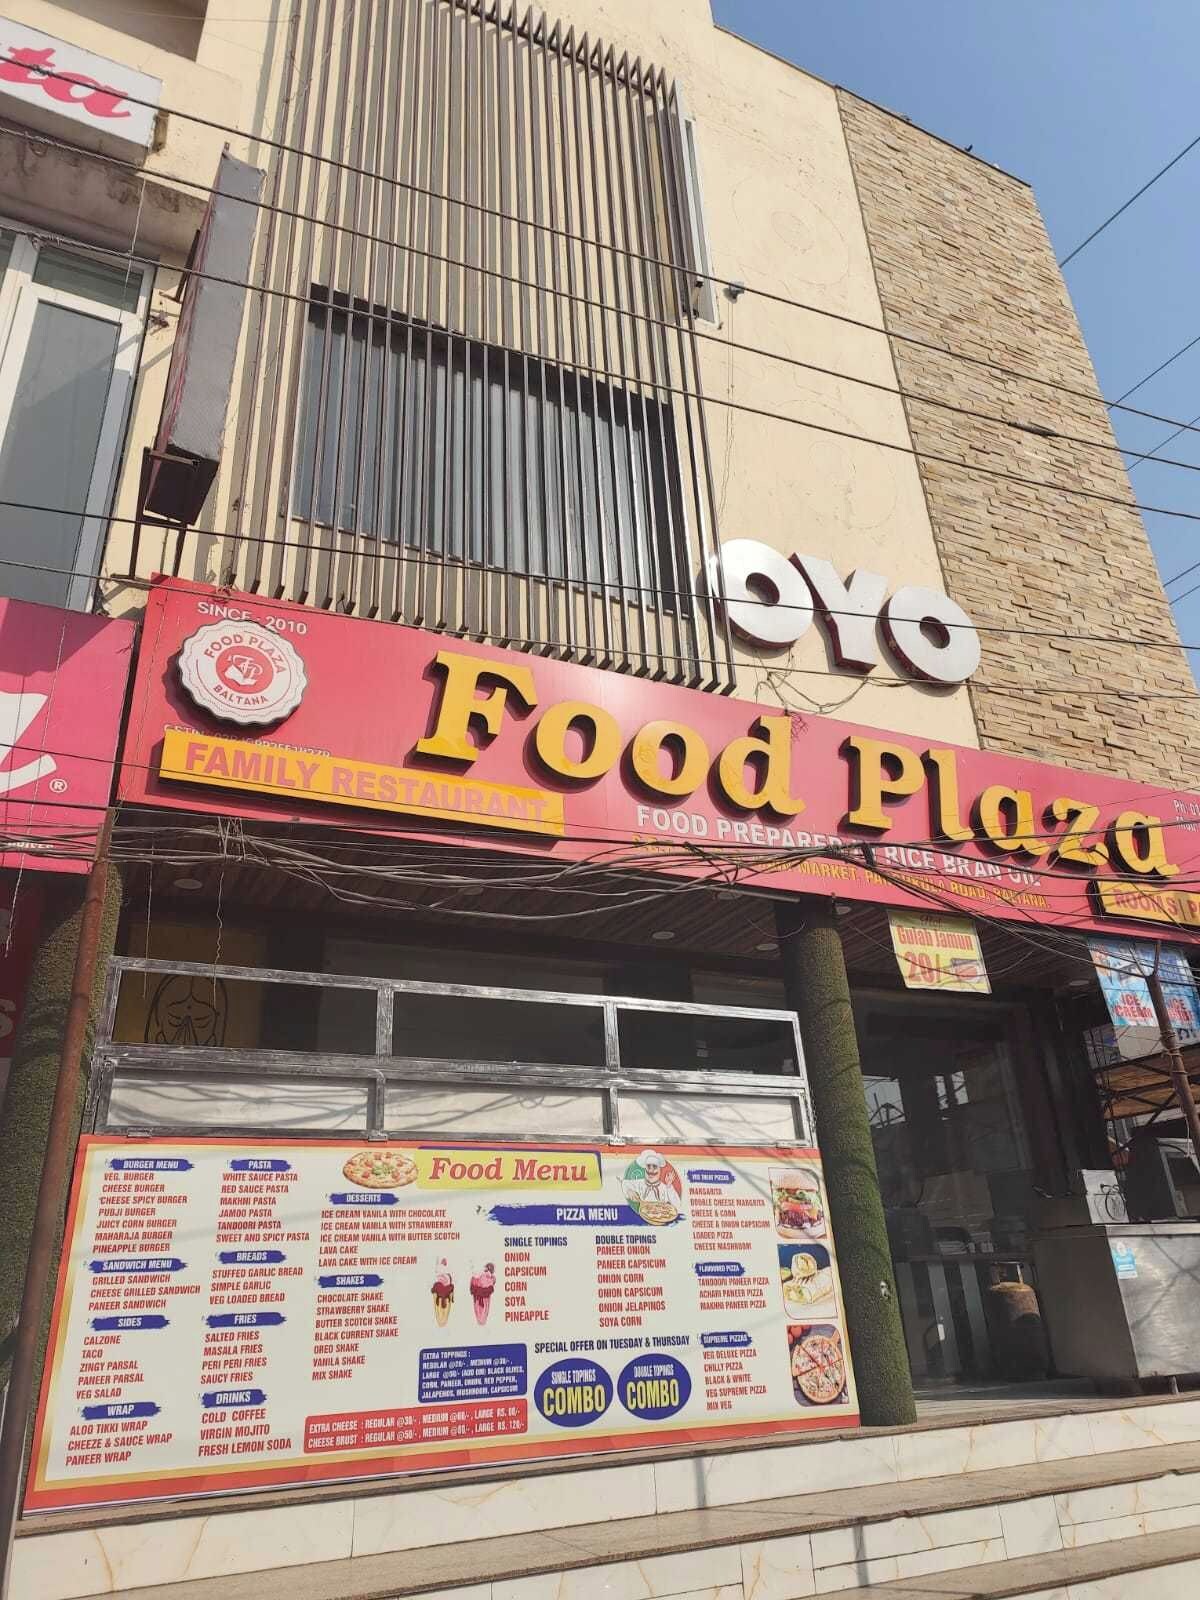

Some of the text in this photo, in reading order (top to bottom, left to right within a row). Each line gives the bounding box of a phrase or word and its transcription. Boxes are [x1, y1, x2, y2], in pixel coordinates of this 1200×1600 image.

[0, 46, 131, 118] ta
[708, 538, 981, 683] OYO
[265, 615, 308, 635] 2010
[203, 633, 287, 674] FOOD PLAZA
[212, 684, 269, 706] BALTANA
[416, 650, 1180, 878] Food Plaza
[184, 741, 549, 821] FAMILY RESTAURANT
[636, 805, 709, 837] FOOD
[885, 845, 936, 870] RICE
[943, 852, 1001, 879] BRAN
[896, 925, 974, 951] Gulab Jamun
[123, 1160, 179, 1169] BURGER MENU
[248, 1160, 272, 1169] PASTA
[429, 1157, 588, 1183] Food Menu
[222, 1173, 298, 1181] WHITE SAUCE PASTA
[102, 1184, 165, 1193] CHEESE BURGER
[100, 1195, 188, 1205] CHEESE SPICY BURGER
[346, 1194, 381, 1202] DESSERTS
[556, 1207, 618, 1221] PIZZA MENU
[216, 1232, 310, 1243] SWEET AND SPICY PASTA
[320, 1232, 460, 1242] ICE CREAM VANILA WITH BUTTER SCOTCH
[504, 1236, 568, 1247] SINGLE TOPINGS
[595, 1235, 657, 1245] DOUBLE TOPINGS
[92, 1243, 170, 1254] PINEAPPLE BURGER
[596, 1246, 651, 1256] PANEER ONION
[236, 1252, 268, 1261] BREADS
[318, 1256, 417, 1267] LAVA CAKE WITH ICE CREAM
[504, 1252, 530, 1262] ONION
[102, 1260, 172, 1271] SANDWICH MENU
[597, 1259, 666, 1270] PANEER CAPSICUM
[212, 1267, 303, 1279] STUFFED GARLIC BREAD
[504, 1266, 547, 1277] CAPSICUM
[92, 1274, 171, 1286] GRILLED SANDWICH
[336, 1276, 365, 1286] SHAKES
[597, 1273, 644, 1284] ONION CORN
[504, 1281, 528, 1292] CORN
[598, 1287, 663, 1298] ONION CAPSICUM
[317, 1292, 384, 1303] CHOCOLATE SHAKE
[504, 1296, 526, 1307] SOYA
[598, 1301, 666, 1313] ONION JELAPINOS
[725, 1300, 749, 1310] PANEER
[750, 1300, 766, 1309] PIZZA
[234, 1314, 257, 1325] FRIES
[315, 1316, 398, 1328] BUTTER SCOTCH SHAKE
[504, 1310, 549, 1322] PINEAPPLE
[599, 1316, 642, 1328] SOYA CORN
[118, 1317, 142, 1328] SIDES
[83, 1335, 122, 1346] CALZONE
[205, 1330, 260, 1343] SALTED FRIES
[534, 1335, 690, 1353] SPECIAL OFFER ON TUESDAY & THURSDAY
[82, 1348, 103, 1358] TACO
[79, 1360, 139, 1373] ZINGY PARSAL
[201, 1357, 267, 1370] PERI PERI FRIES
[704, 1362, 743, 1372] CHILLY PIZZA
[312, 1369, 353, 1381] MIX SHAKE
[551, 1369, 596, 1385] SINGLE TOPINGS
[633, 1364, 674, 1378] DOUBLE TOPINGS
[705, 1376, 725, 1385] BLACK
[732, 1374, 752, 1382] WHITE
[626, 1379, 680, 1410] COMBO
[706, 1385, 766, 1398] VEG SUPREME PIZZA
[215, 1392, 251, 1405] DRINKS
[543, 1384, 606, 1417] COMBO
[107, 1405, 135, 1417] WRAP
[202, 1408, 267, 1424] COLD COFFEE
[200, 1423, 270, 1440] VIRGIN MOJITO
[309, 1421, 358, 1434] EXTRA CHEESE
[68, 1433, 173, 1451] CHEEZE & SAUCE WRAP
[198, 1438, 292, 1457] FRESH LEMON SODA
[308, 1438, 334, 1449] CHEESE
[65, 1451, 132, 1466] PANEER WRAP
